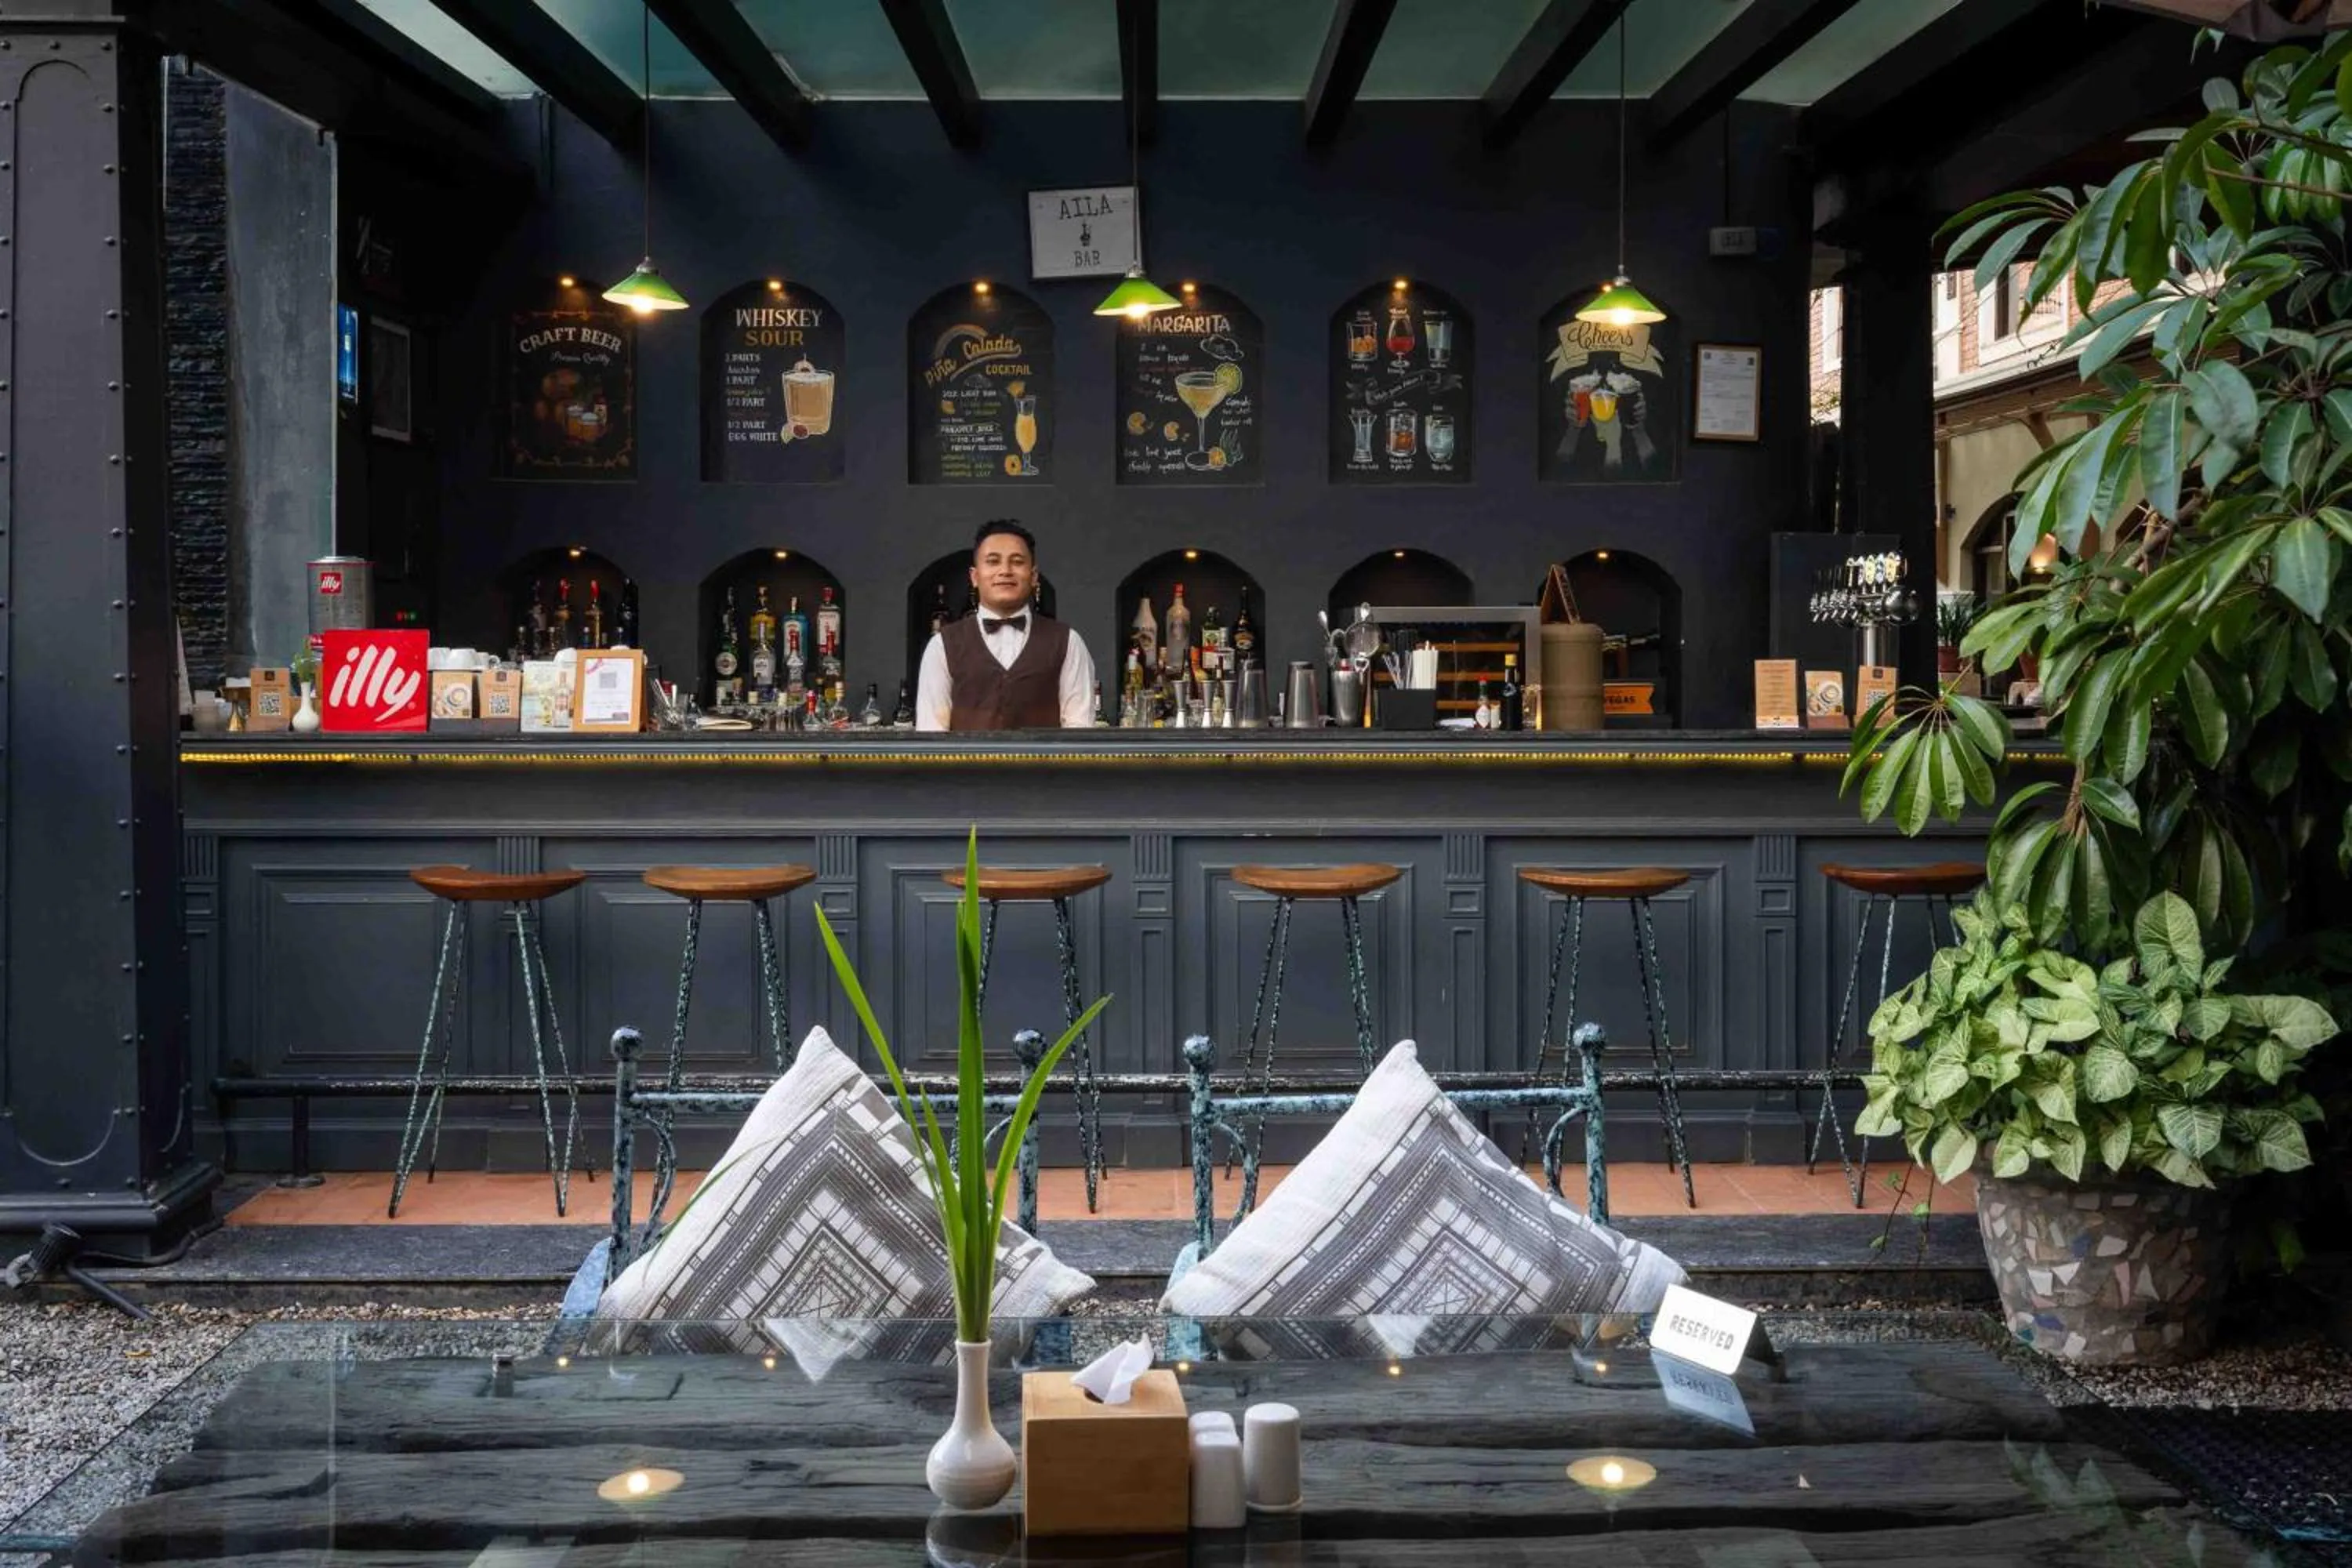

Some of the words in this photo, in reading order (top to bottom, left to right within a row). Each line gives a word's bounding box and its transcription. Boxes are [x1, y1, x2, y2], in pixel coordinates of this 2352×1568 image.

[1059, 194, 1114, 220] AILA
[1073, 250, 1101, 267] BAR
[735, 308, 822, 328] WHISKEY
[1138, 314, 1232, 334] MARGARITA
[519, 326, 577, 354] CRAFT
[579, 327, 622, 353] BEER
[745, 329, 804, 347] SOUR
[1568, 321, 1633, 350] Cheers
[985, 363, 1033, 376] COCKTAIL
[728, 431, 748, 442] EGG
[749, 431, 779, 442] WHITE
[321, 575, 340, 592] illy
[328, 644, 421, 722] illy
[1669, 1315, 1734, 1350] RESERVED
